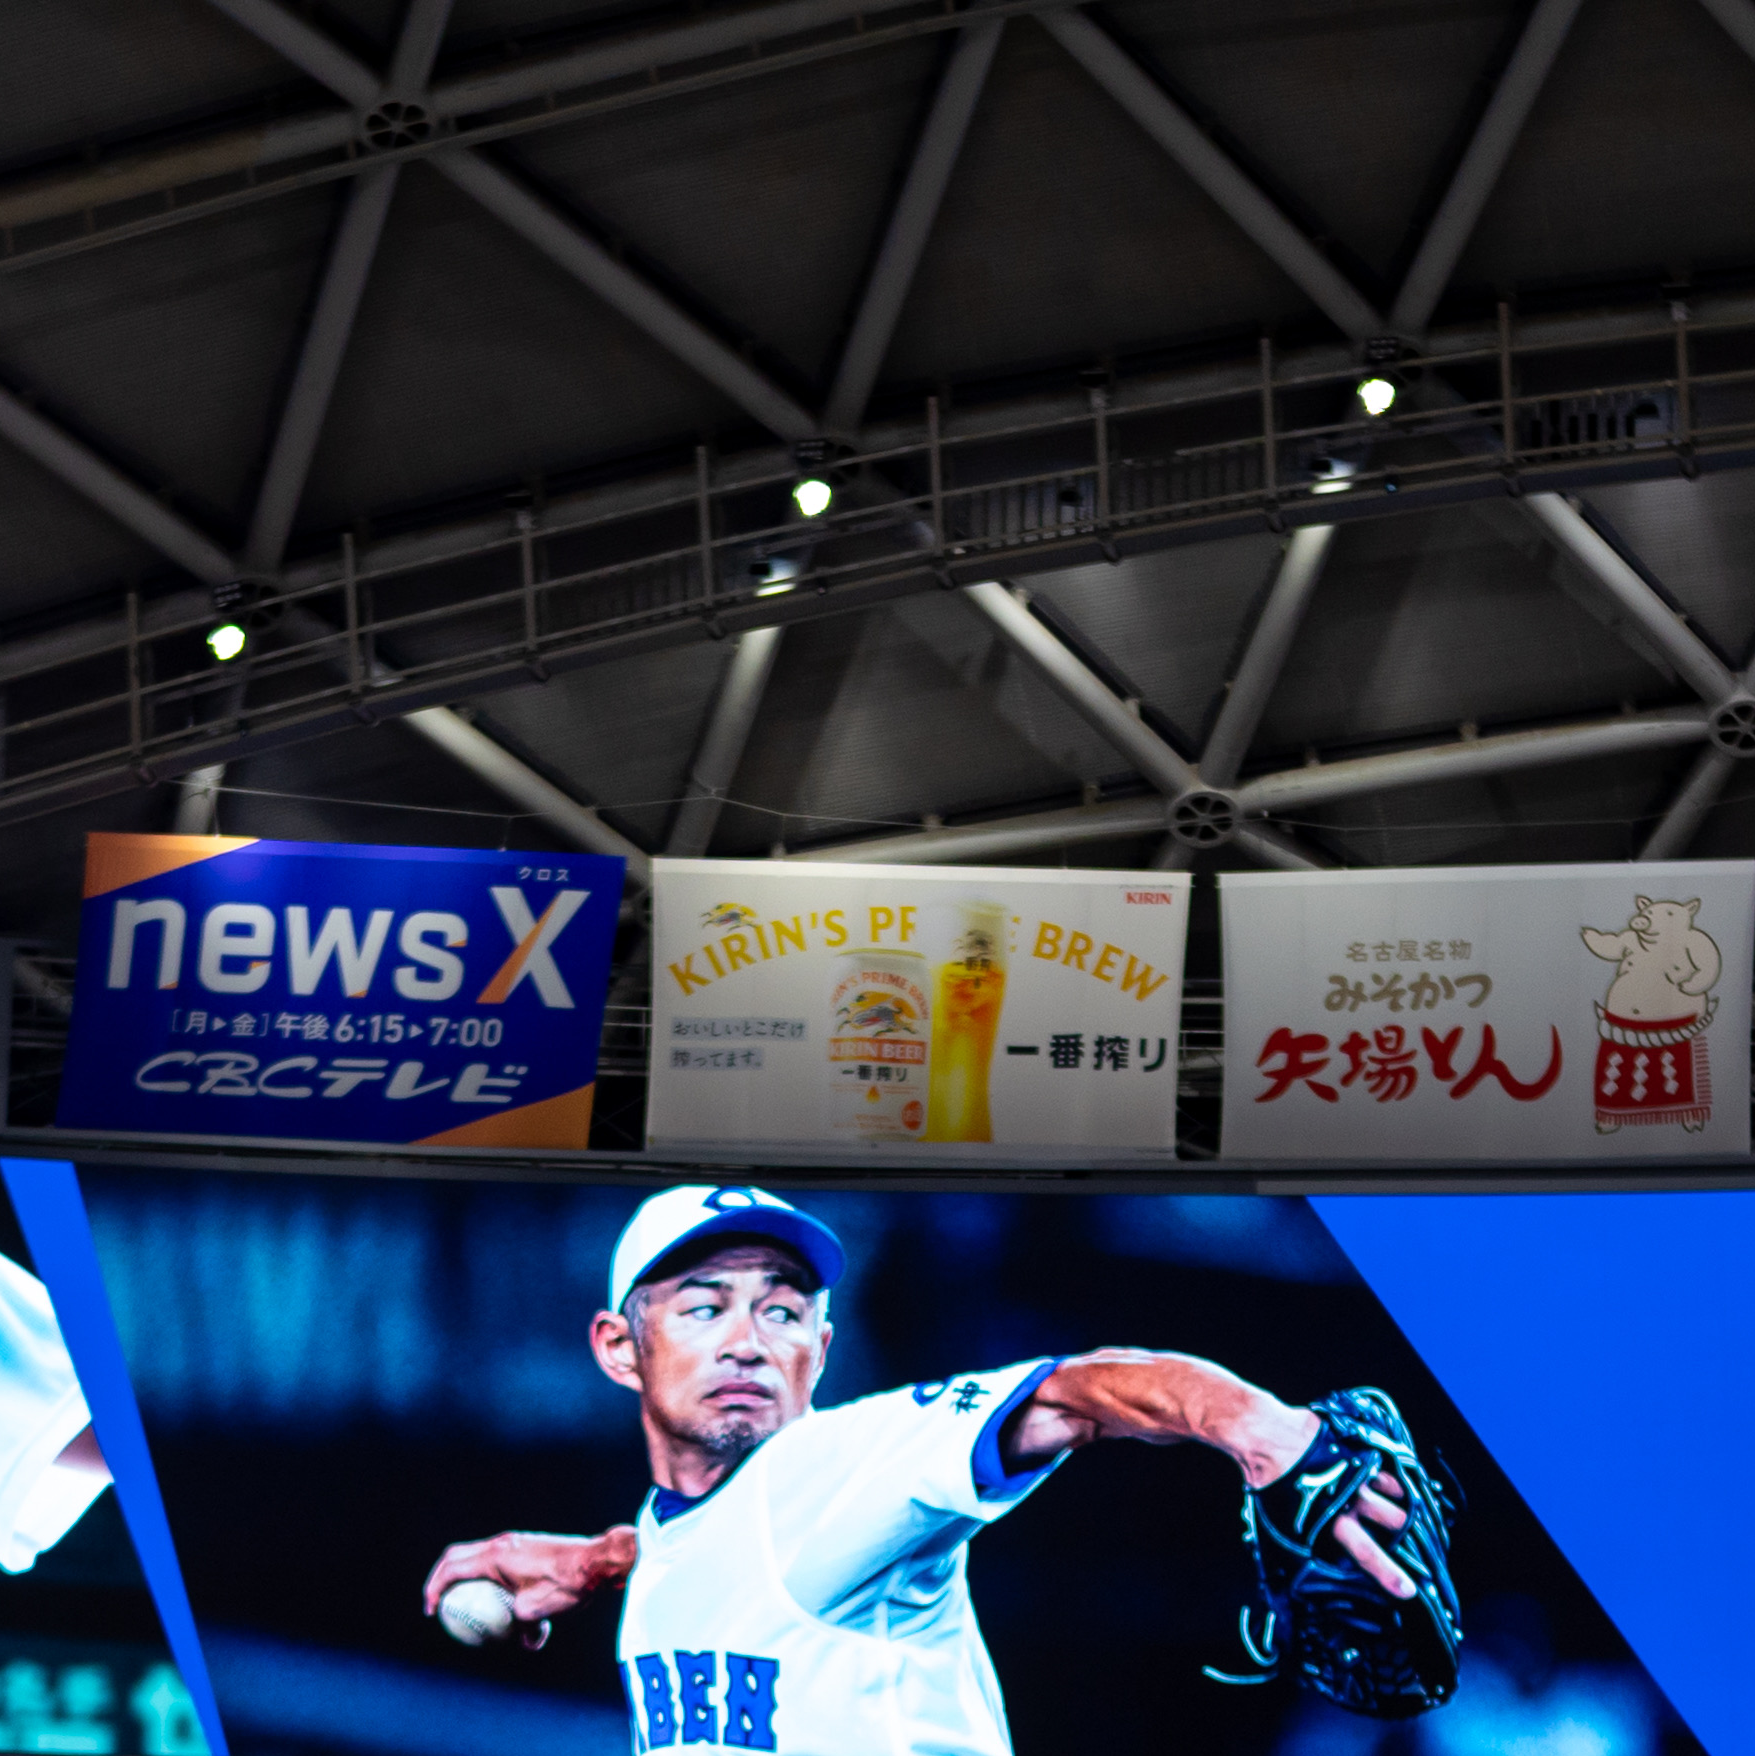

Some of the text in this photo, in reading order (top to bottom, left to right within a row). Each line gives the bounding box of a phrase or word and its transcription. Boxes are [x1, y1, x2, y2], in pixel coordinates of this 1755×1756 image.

[517, 865, 570, 882] クロス
[1125, 890, 1172, 905] KIRIN
[667, 909, 846, 997] KIRIN'S
[1032, 922, 1171, 1001] BREW
[1346, 940, 1472, 963] 名古屋名物
[1323, 973, 1493, 1013] みそかつ
[1006, 1033, 1167, 1072] 一番搾り
[1255, 1023, 1563, 1104] 矢場とん
[135, 1051, 529, 1103] CBCテレビ
